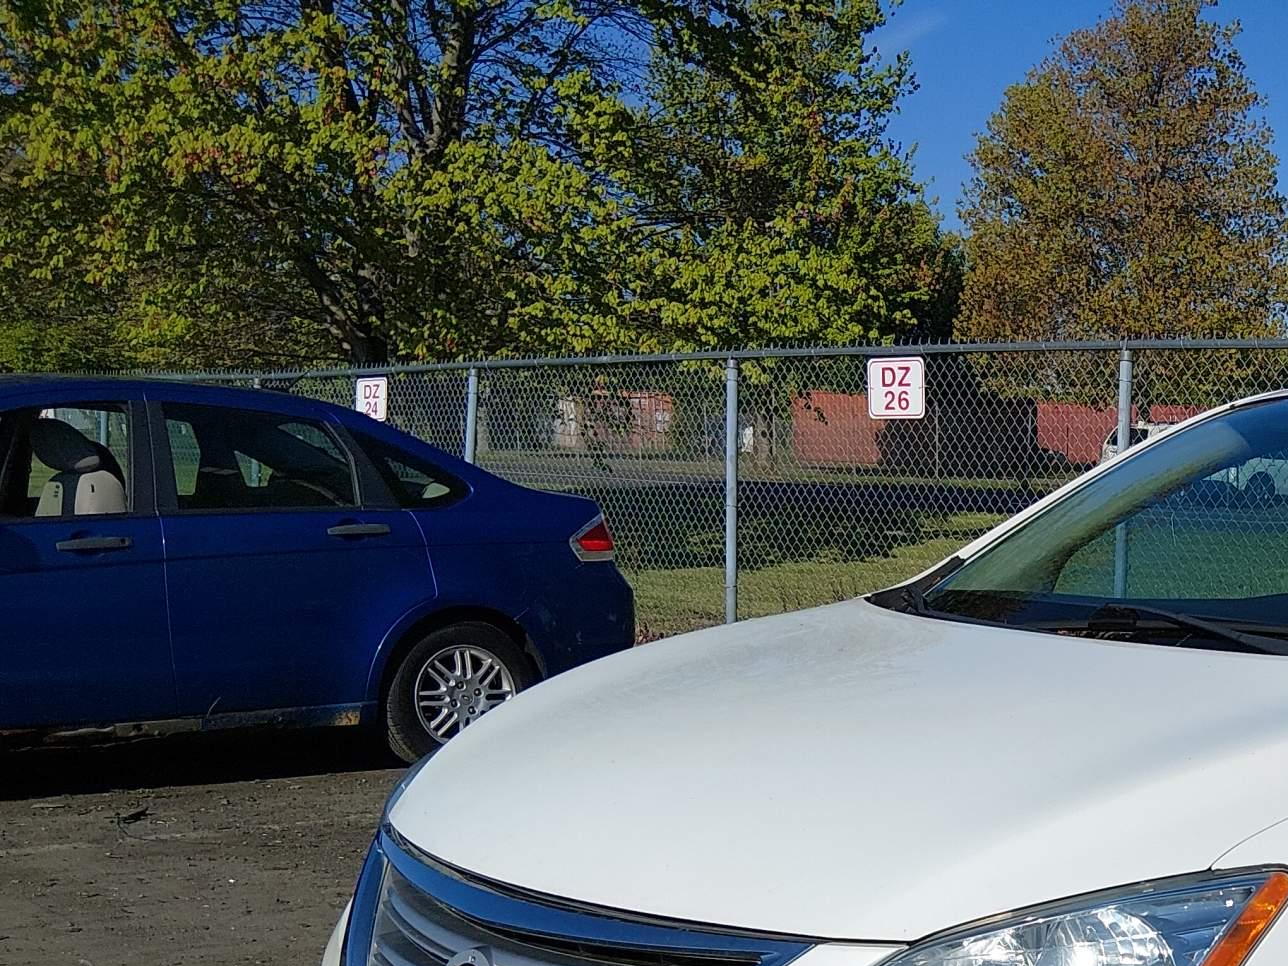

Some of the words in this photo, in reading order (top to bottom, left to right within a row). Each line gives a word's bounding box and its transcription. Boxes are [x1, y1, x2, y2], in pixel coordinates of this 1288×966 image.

[881, 366, 911, 388] DZ
[363, 384, 380, 399] DZ
[884, 390, 910, 411] 26
[365, 401, 378, 416] 24
